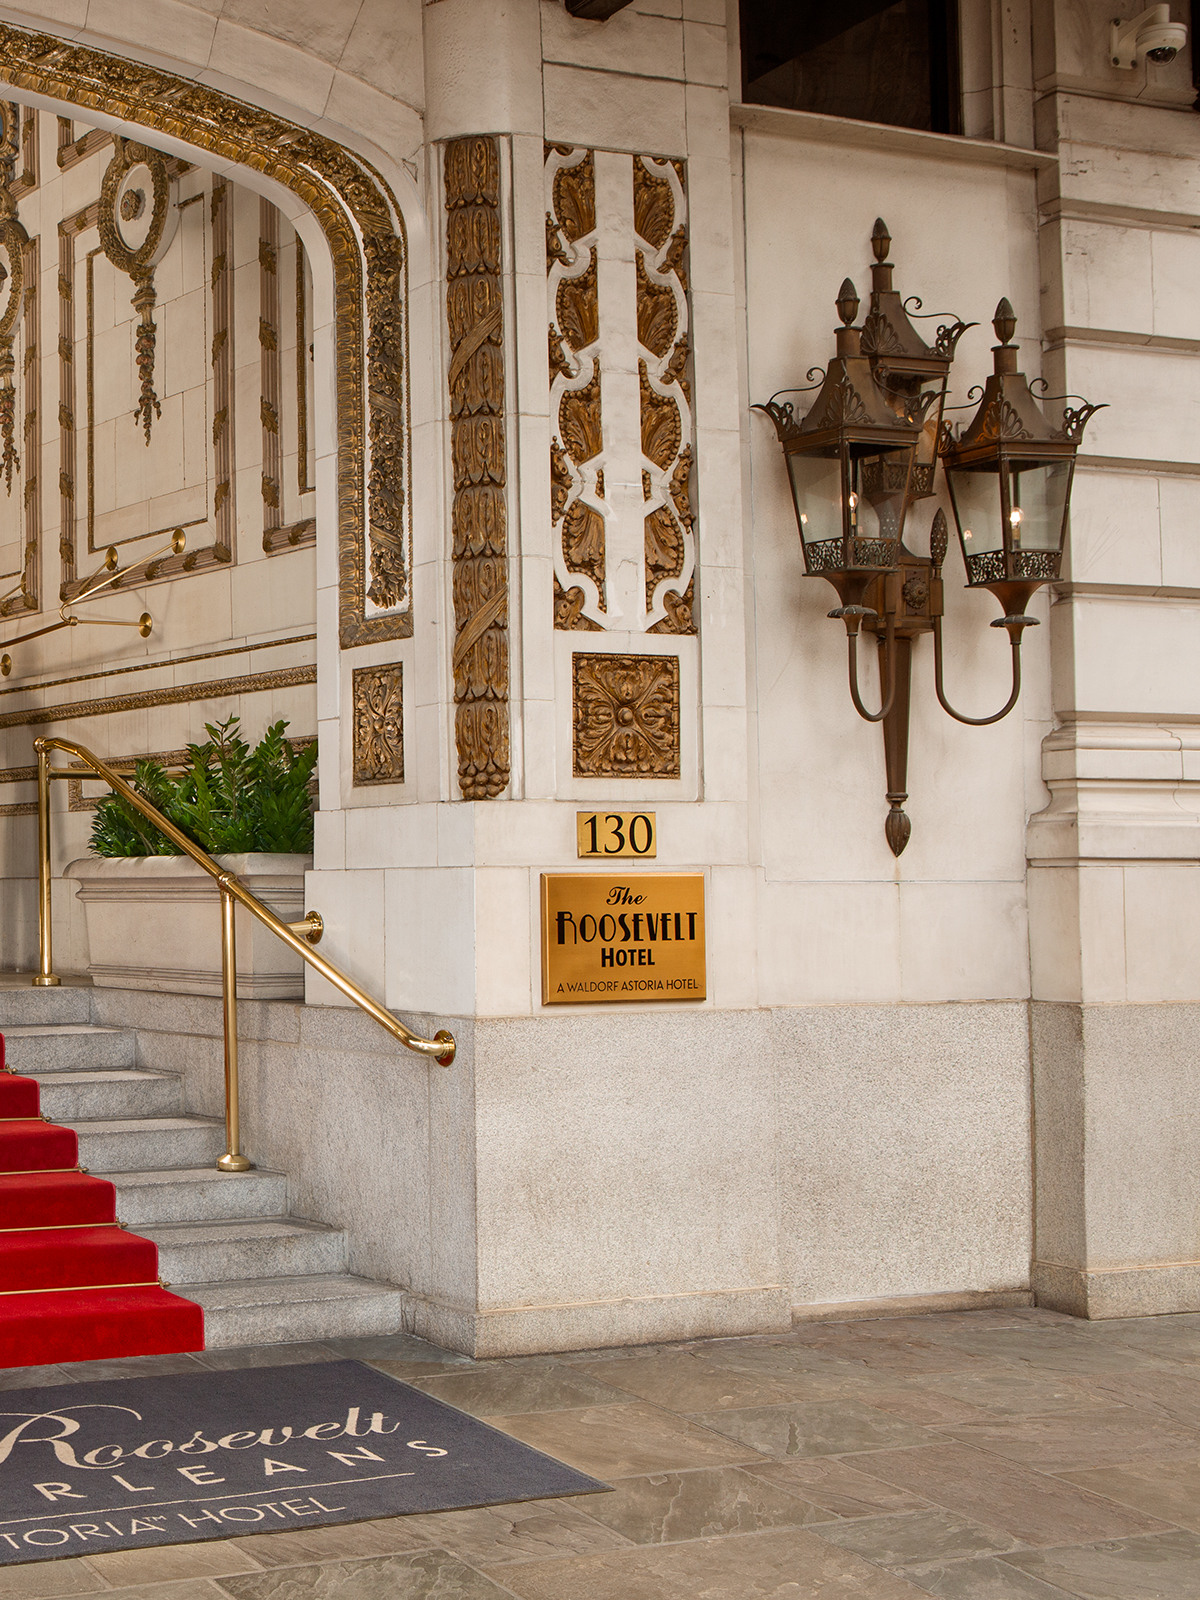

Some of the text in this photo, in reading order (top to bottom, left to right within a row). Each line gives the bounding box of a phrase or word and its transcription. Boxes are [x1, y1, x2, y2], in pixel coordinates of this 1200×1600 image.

[584, 814, 653, 854] 130
[606, 886, 648, 906] The
[555, 911, 698, 945] ROOSEVELT
[601, 948, 656, 968] HOTEL
[556, 979, 699, 993] A WALDORF ASTORIA HOTEL
[178, 1497, 348, 1528] HOTEL
